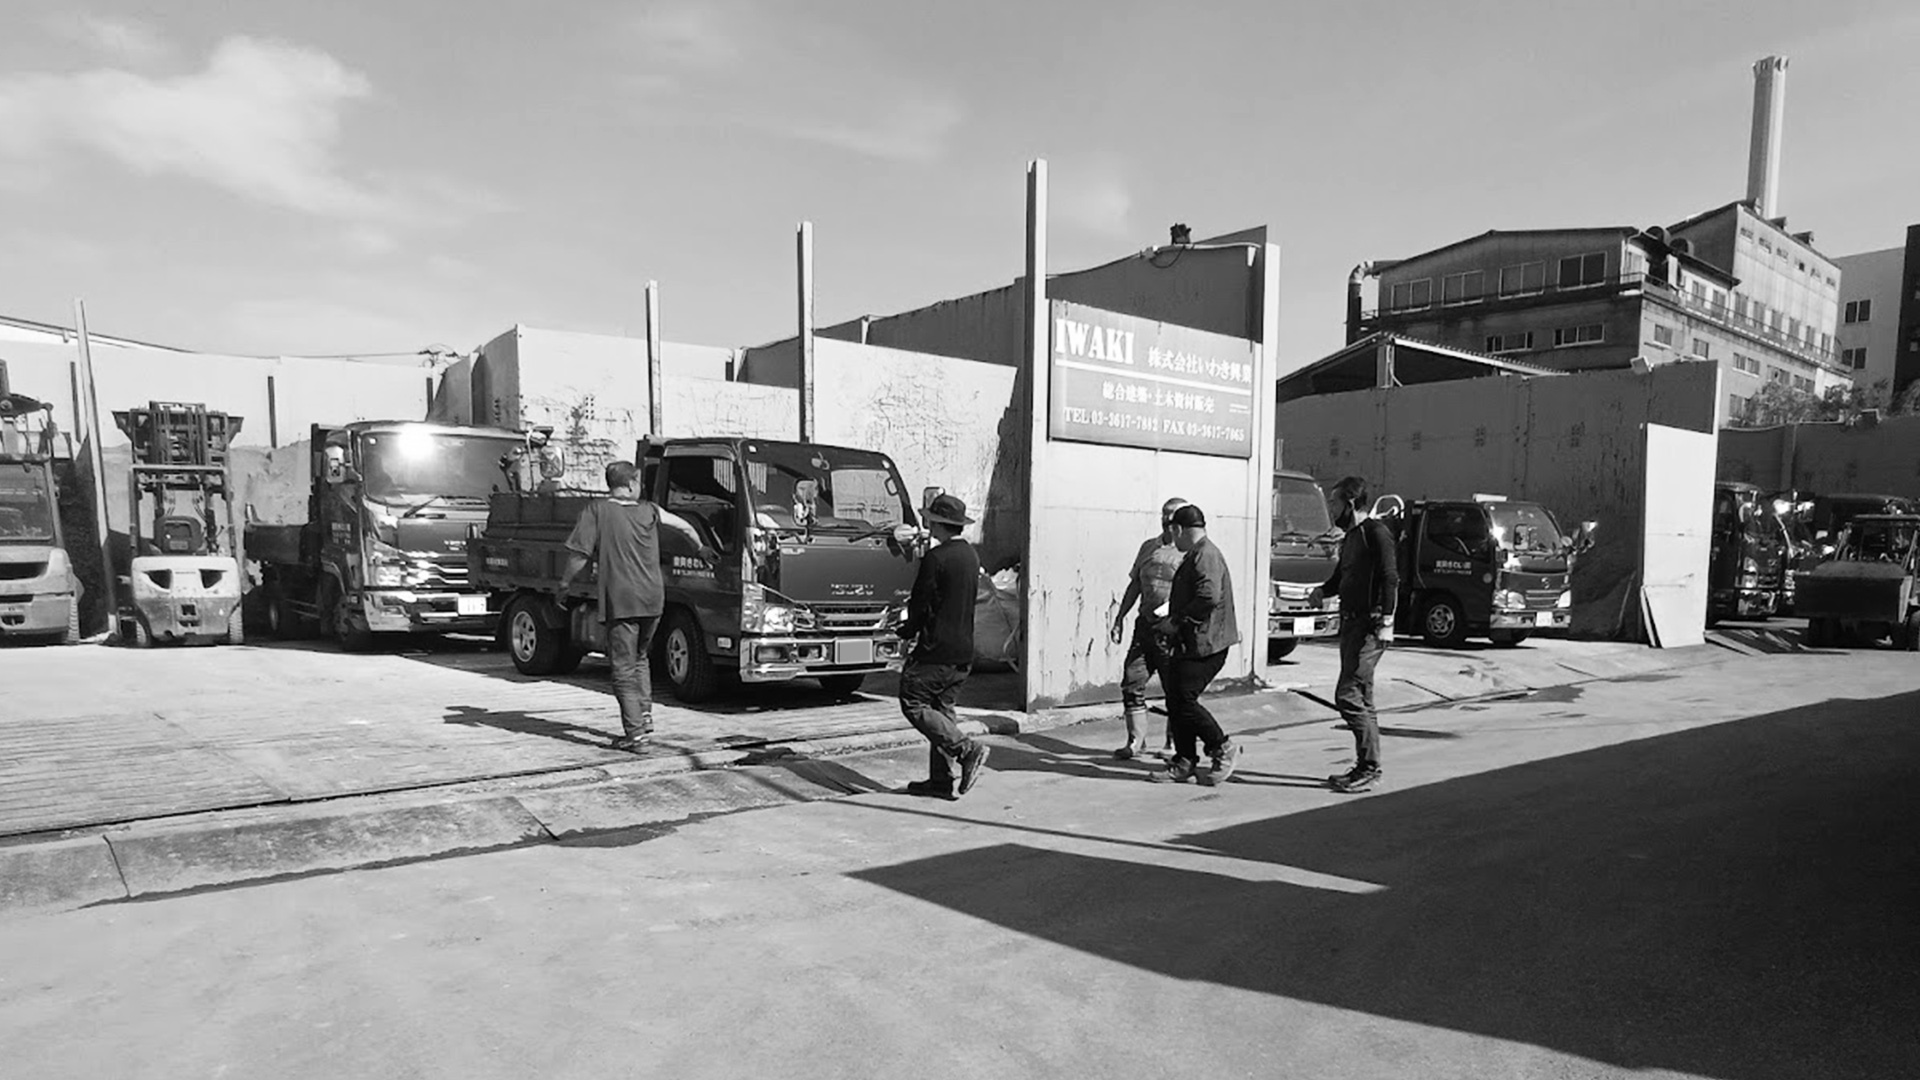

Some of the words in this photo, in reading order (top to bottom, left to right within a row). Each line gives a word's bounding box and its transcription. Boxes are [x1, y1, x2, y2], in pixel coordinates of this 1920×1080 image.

[1055, 318, 1135, 364] IWAKI
[1063, 406, 1090, 424] TEL
[1163, 419, 1186, 435] FAX
